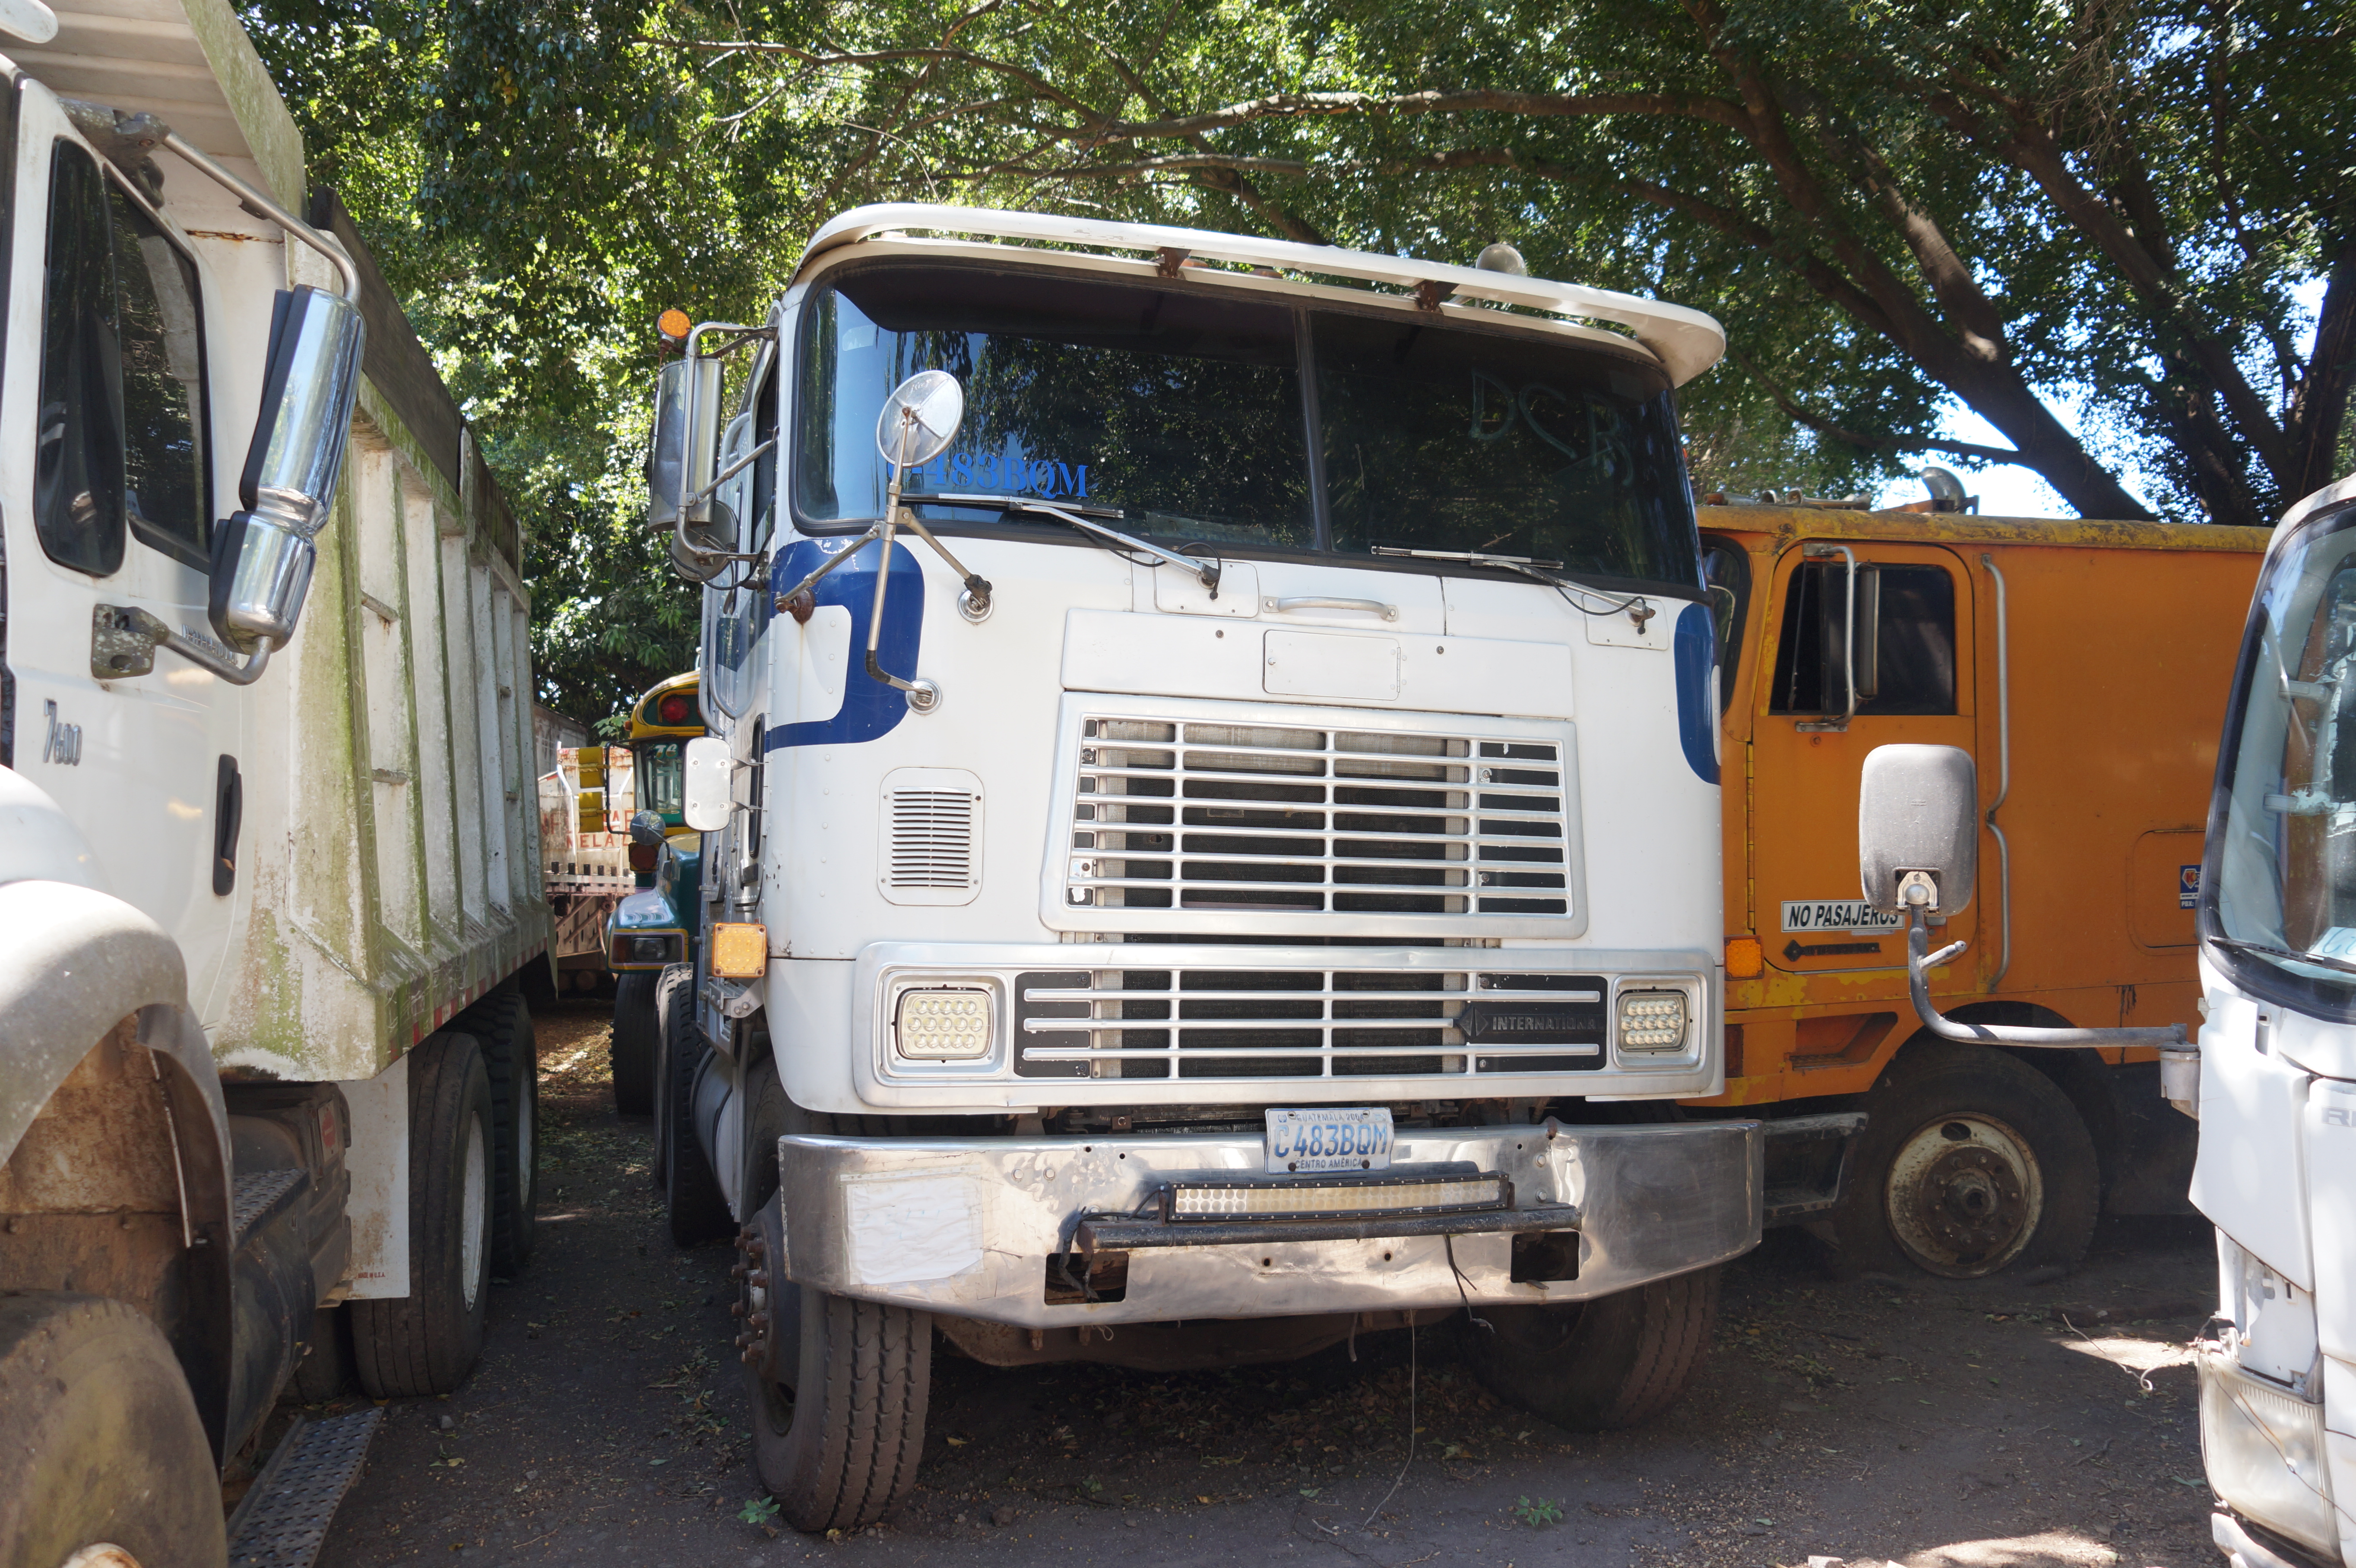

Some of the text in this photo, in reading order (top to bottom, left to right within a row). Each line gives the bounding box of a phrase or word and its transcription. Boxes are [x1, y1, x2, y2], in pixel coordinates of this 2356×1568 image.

[1788, 905, 1811, 927] NO
[1295, 1113, 1343, 1122] GUATEMALA
[1295, 1159, 1326, 1169] CENTRO
